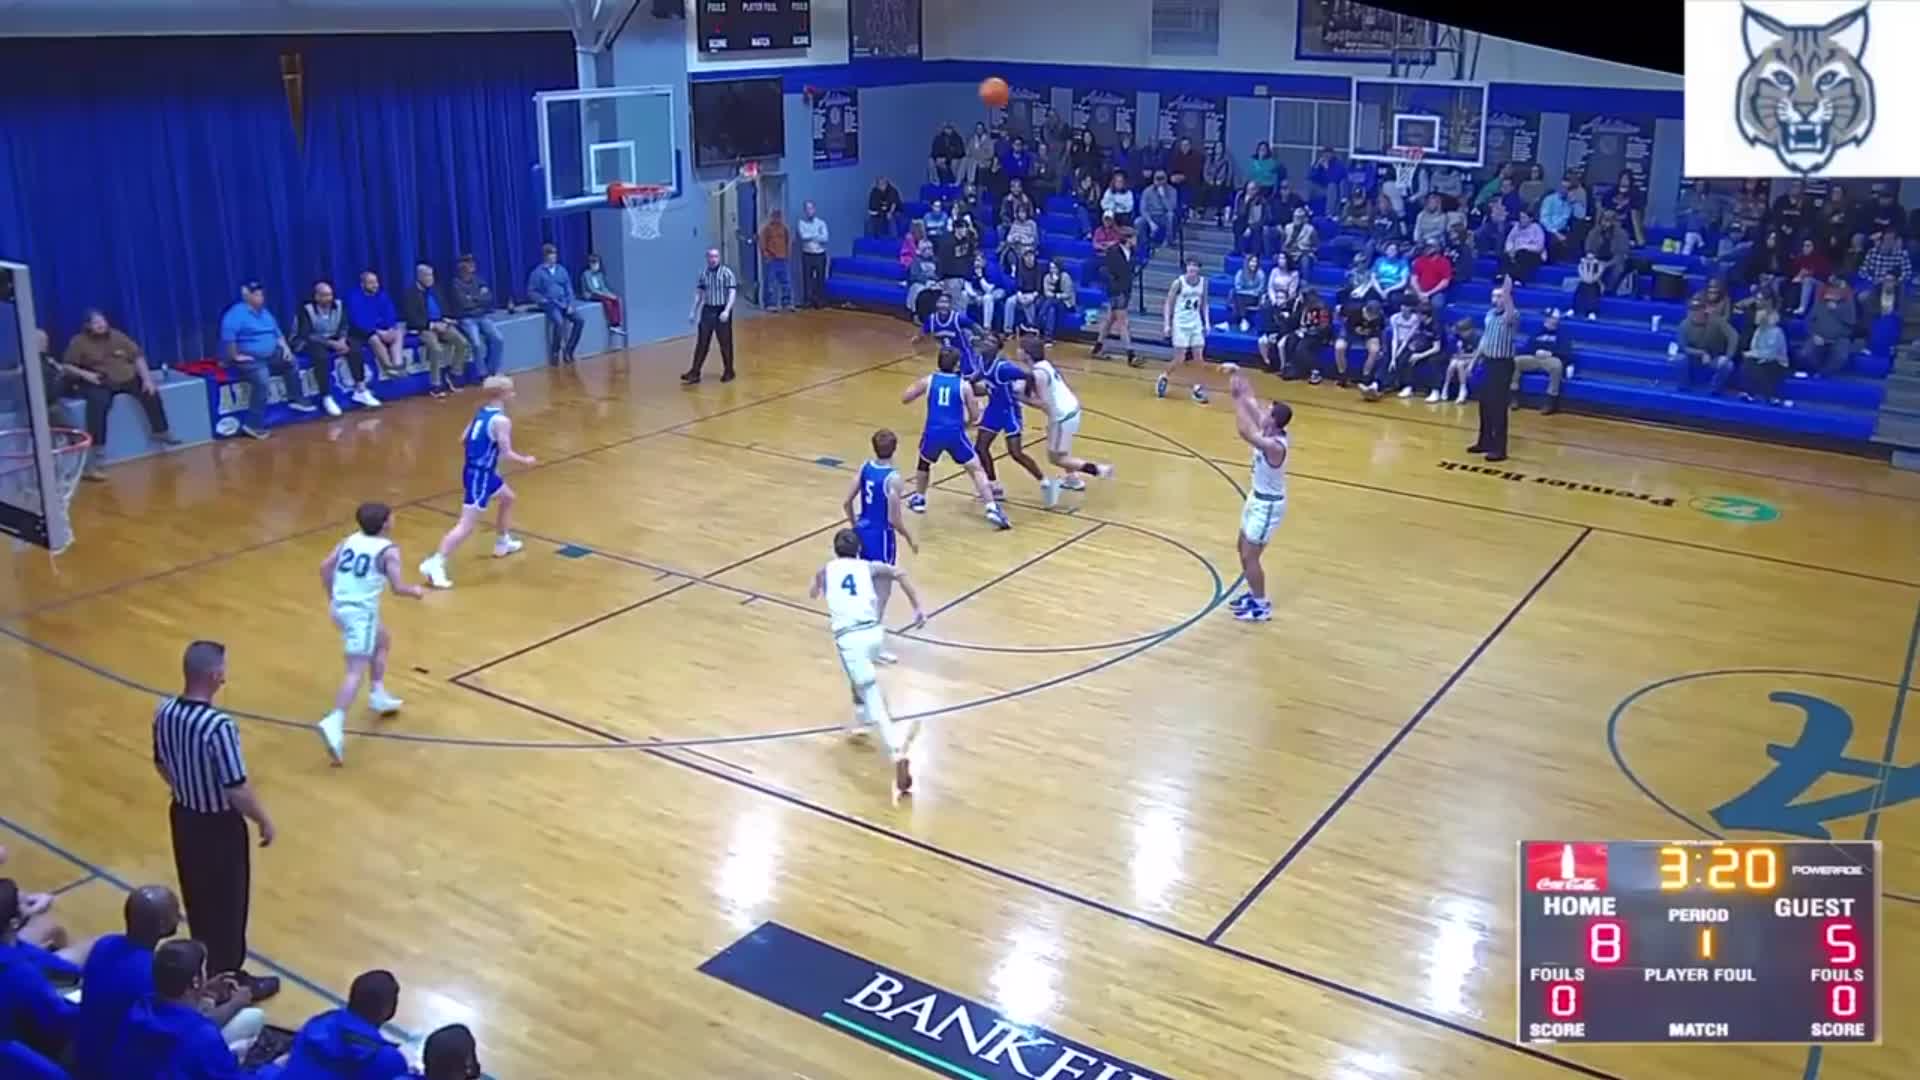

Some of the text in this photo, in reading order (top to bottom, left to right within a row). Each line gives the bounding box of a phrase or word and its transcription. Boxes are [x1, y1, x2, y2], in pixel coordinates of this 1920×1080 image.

[938, 386, 950, 406] 11
[865, 480, 875, 504] 5
[1533, 477, 1677, 507] Premier
[338, 548, 370, 578] 20
[841, 573, 857, 596] 4
